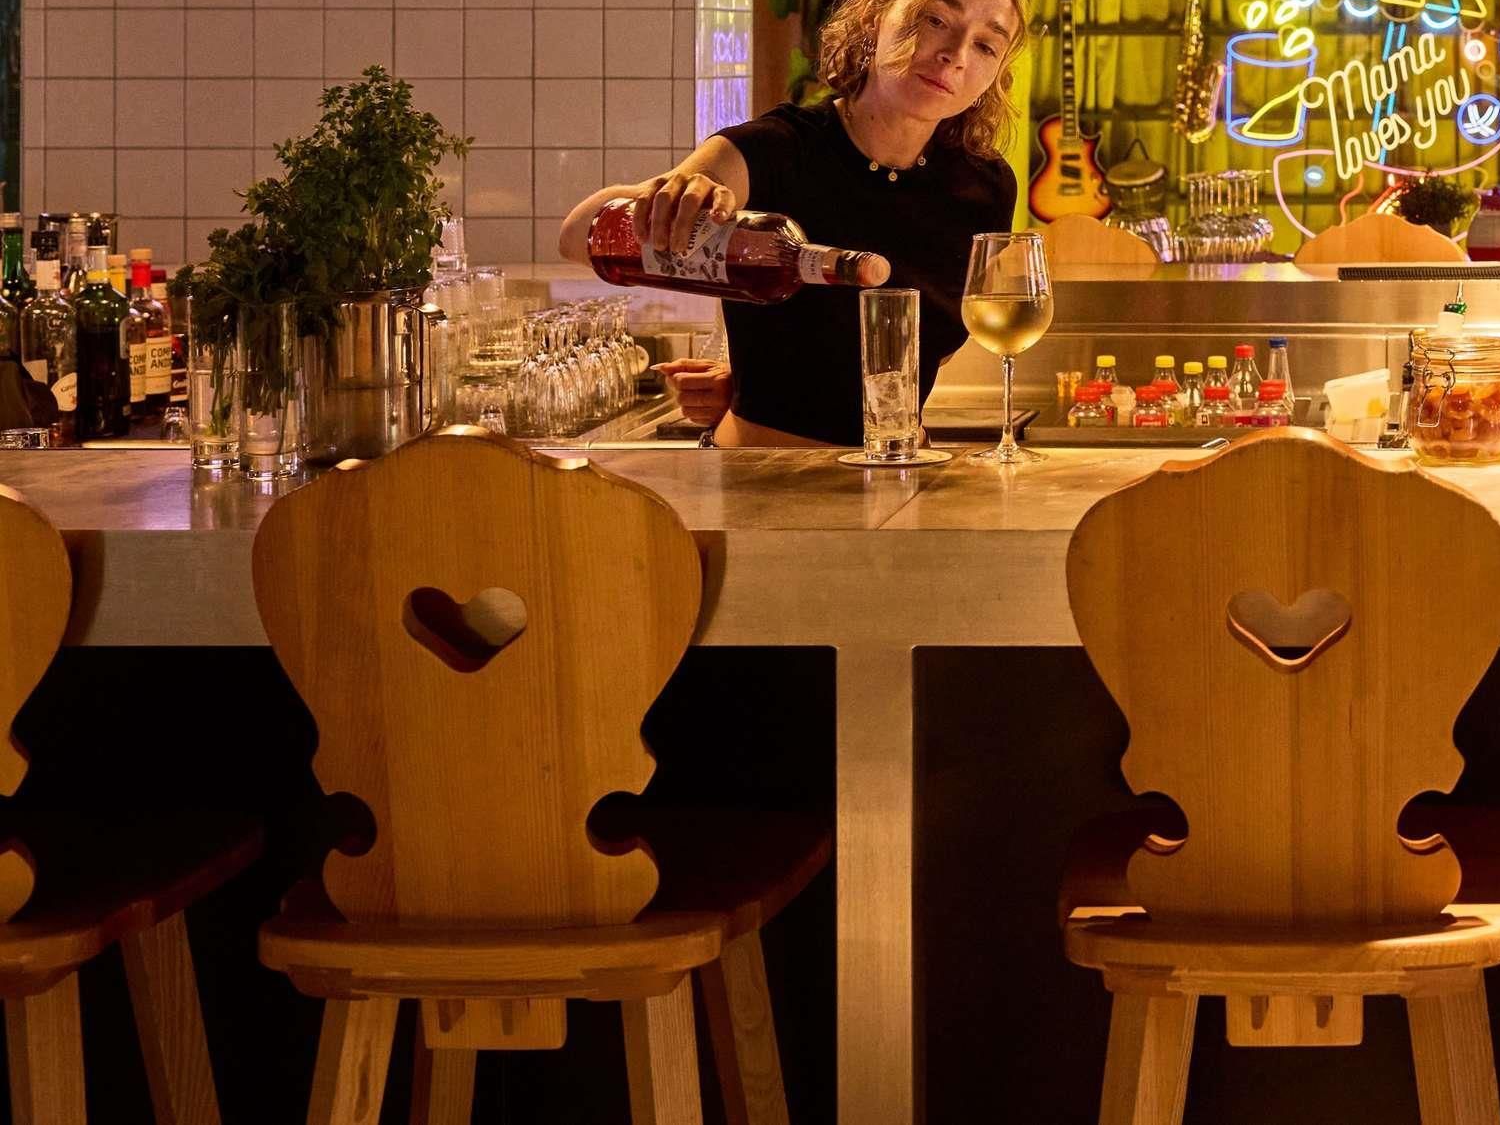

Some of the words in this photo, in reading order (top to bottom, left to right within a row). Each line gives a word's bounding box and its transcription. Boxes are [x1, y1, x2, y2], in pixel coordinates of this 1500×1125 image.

[1300, 33, 1446, 122] Mama
[1333, 110, 1412, 180] loves
[1414, 68, 1471, 150] you
